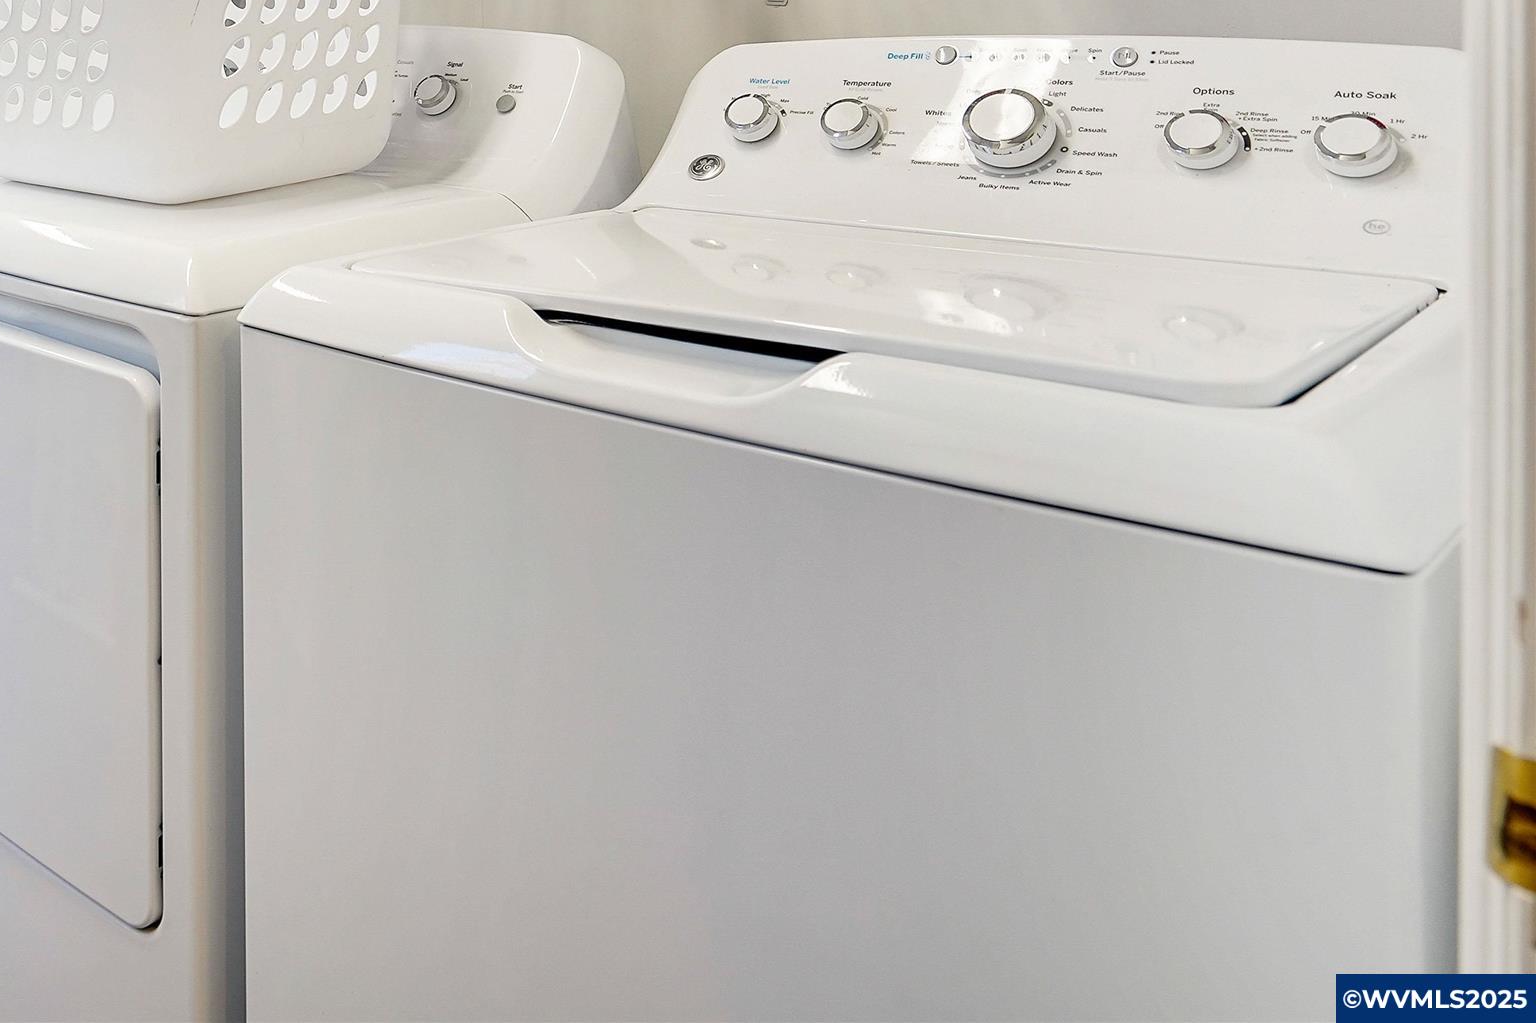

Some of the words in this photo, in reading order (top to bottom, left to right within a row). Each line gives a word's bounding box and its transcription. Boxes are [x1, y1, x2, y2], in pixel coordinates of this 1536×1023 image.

[887, 53, 909, 61] Deep
[749, 77, 770, 85] Water
[843, 79, 892, 88] Temperature
[1193, 87, 1235, 96] Options
[1334, 91, 1363, 99] Auto
[1367, 91, 1397, 99] Soak
[1072, 150, 1096, 158] Speed
